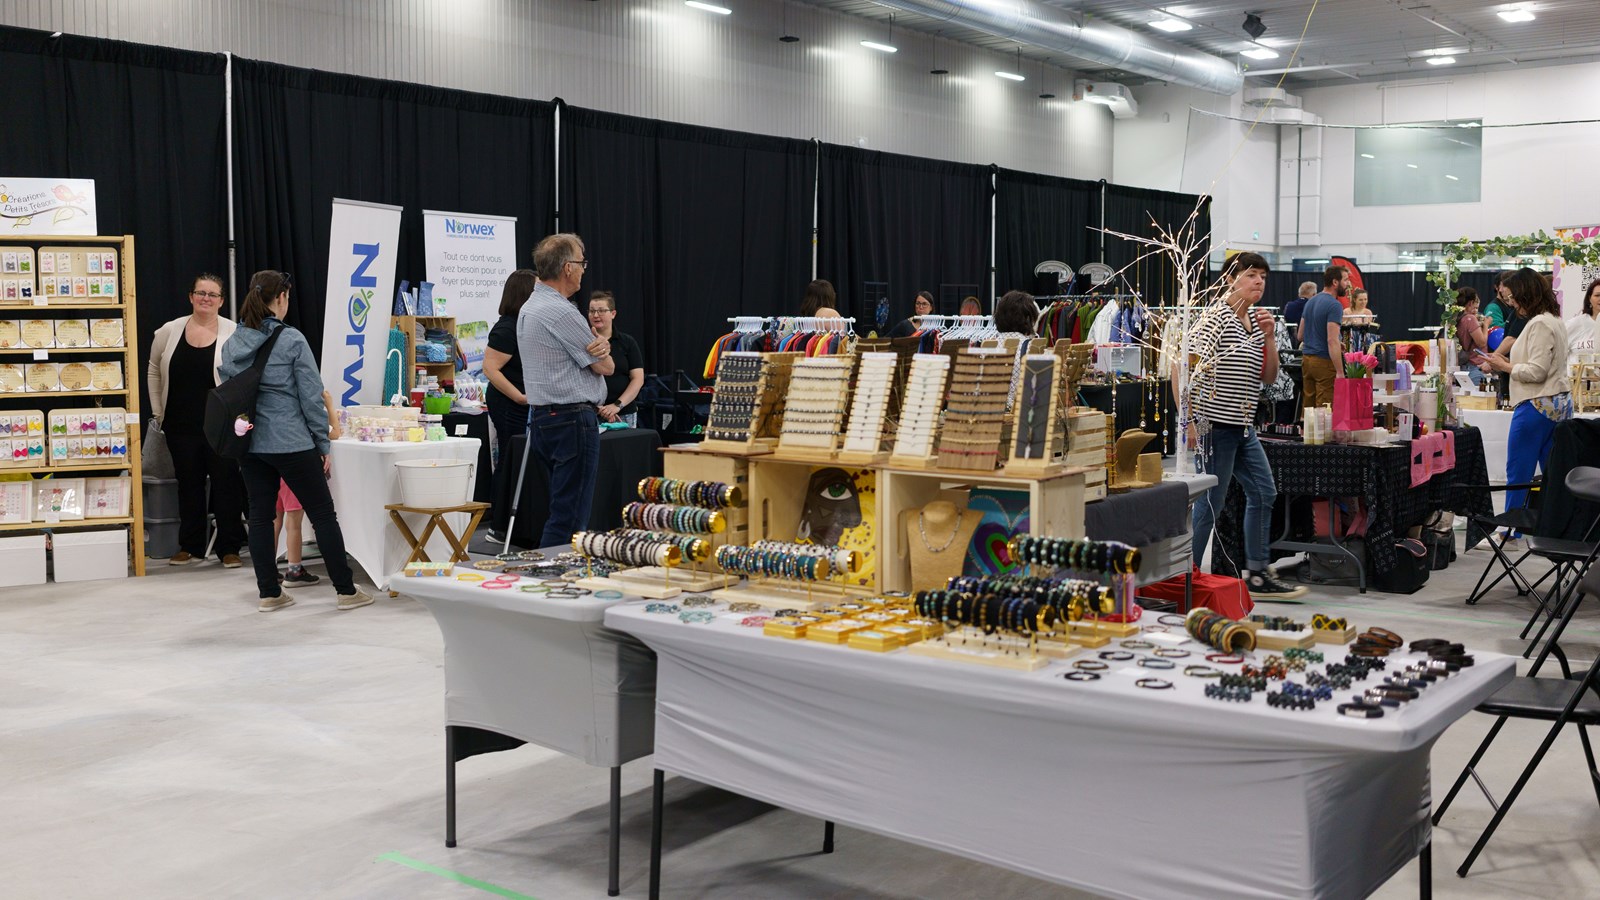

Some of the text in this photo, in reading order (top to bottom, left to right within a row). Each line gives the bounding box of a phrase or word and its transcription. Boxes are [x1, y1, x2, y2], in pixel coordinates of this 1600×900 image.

[7, 191, 46, 204] Créations
[4, 204, 29, 213] Petits
[445, 218, 495, 236] Norwex
[443, 251, 458, 261] Tout
[469, 253, 485, 262] dont
[487, 255, 502, 263] vous
[440, 265, 455, 273] avez
[457, 265, 479, 274] besoin
[481, 268, 496, 276] pour
[442, 276, 458, 287] foyer
[460, 278, 474, 288] plus
[475, 279, 498, 288] propre
[460, 290, 490, 298] plus sain!
[1577, 341, 1585, 349] LA
